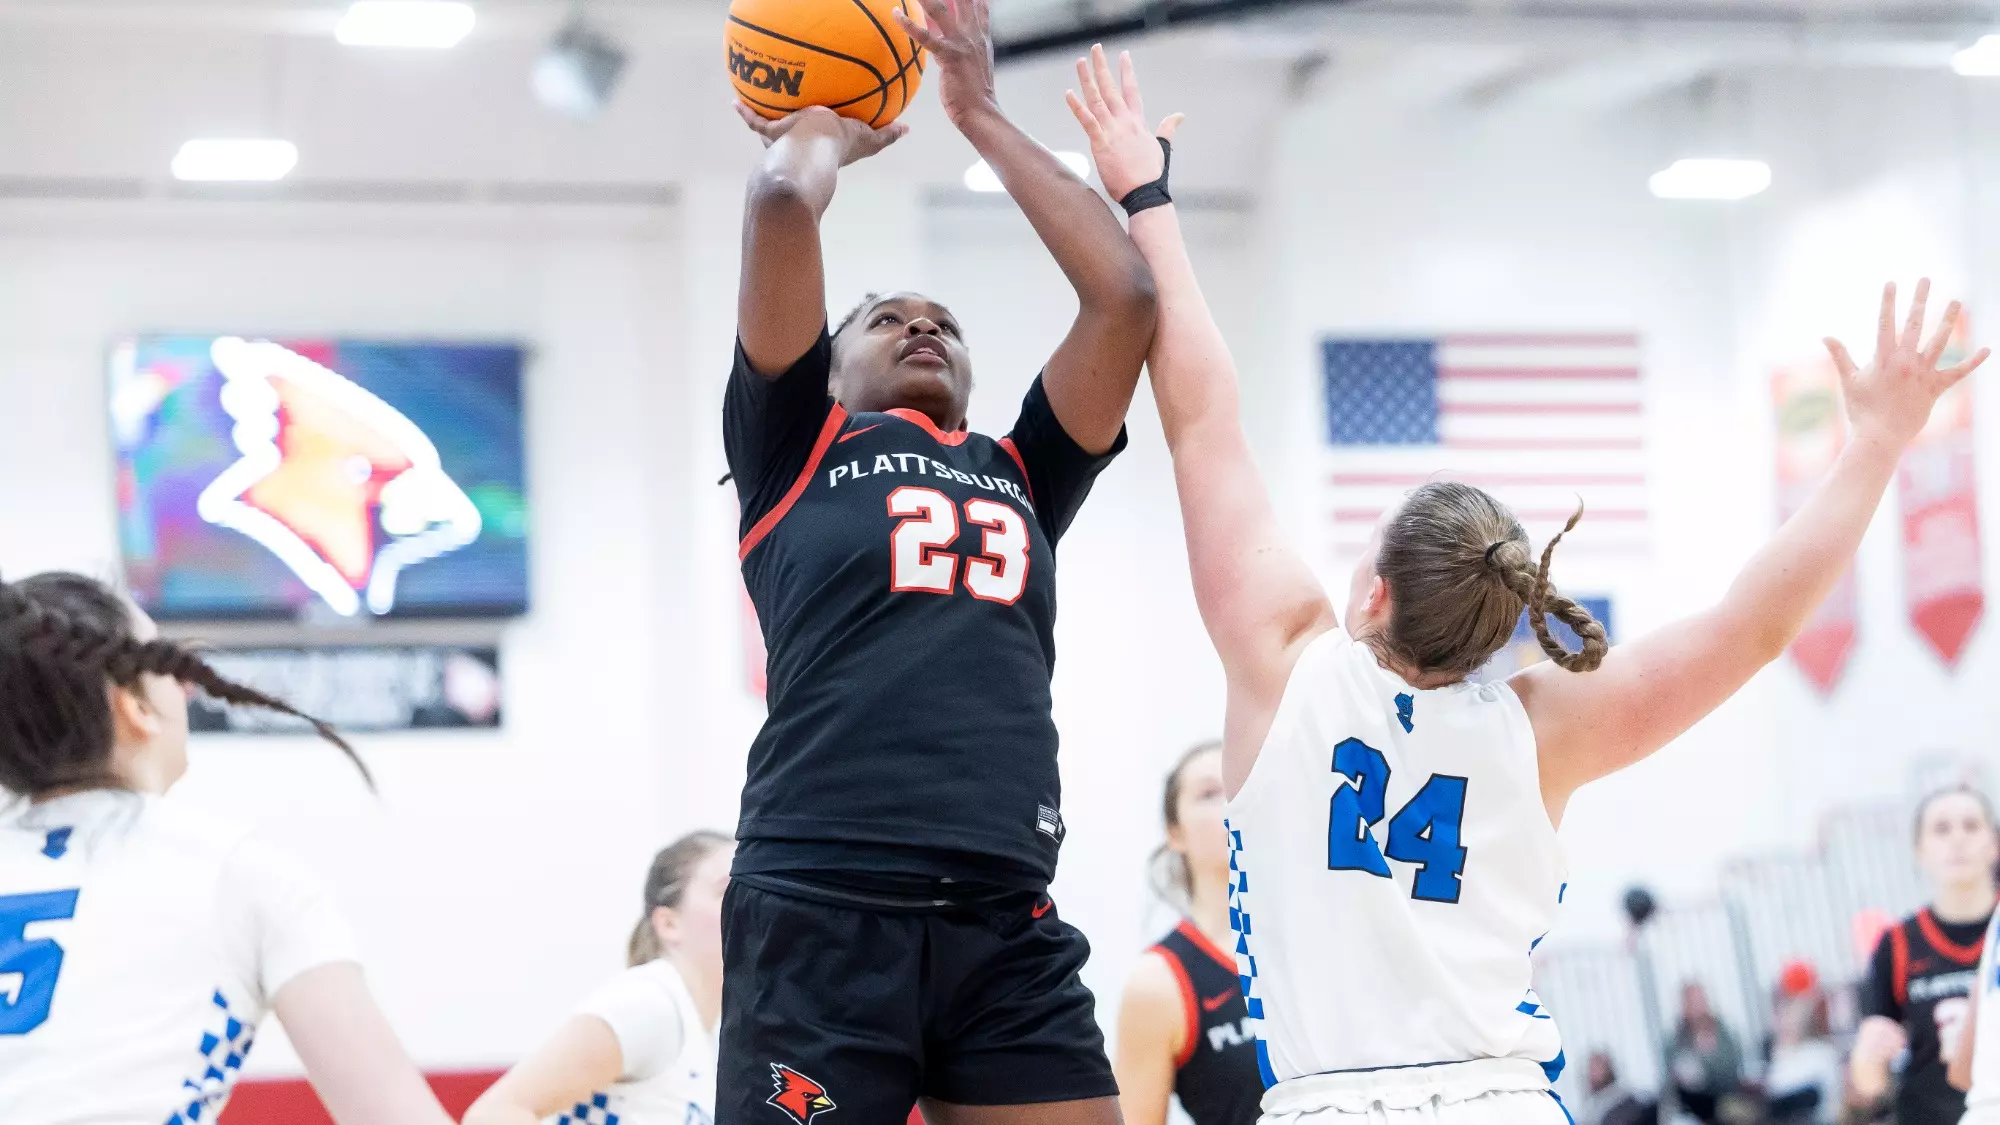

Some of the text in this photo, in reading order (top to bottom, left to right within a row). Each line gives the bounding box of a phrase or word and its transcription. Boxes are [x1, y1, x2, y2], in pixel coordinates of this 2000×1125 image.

[728, 45, 805, 98] NCAA
[766, 55, 806, 68] OFFICIAL
[886, 485, 1031, 607] 23
[1328, 736, 1469, 905] 24
[0, 887, 81, 1036] 5
